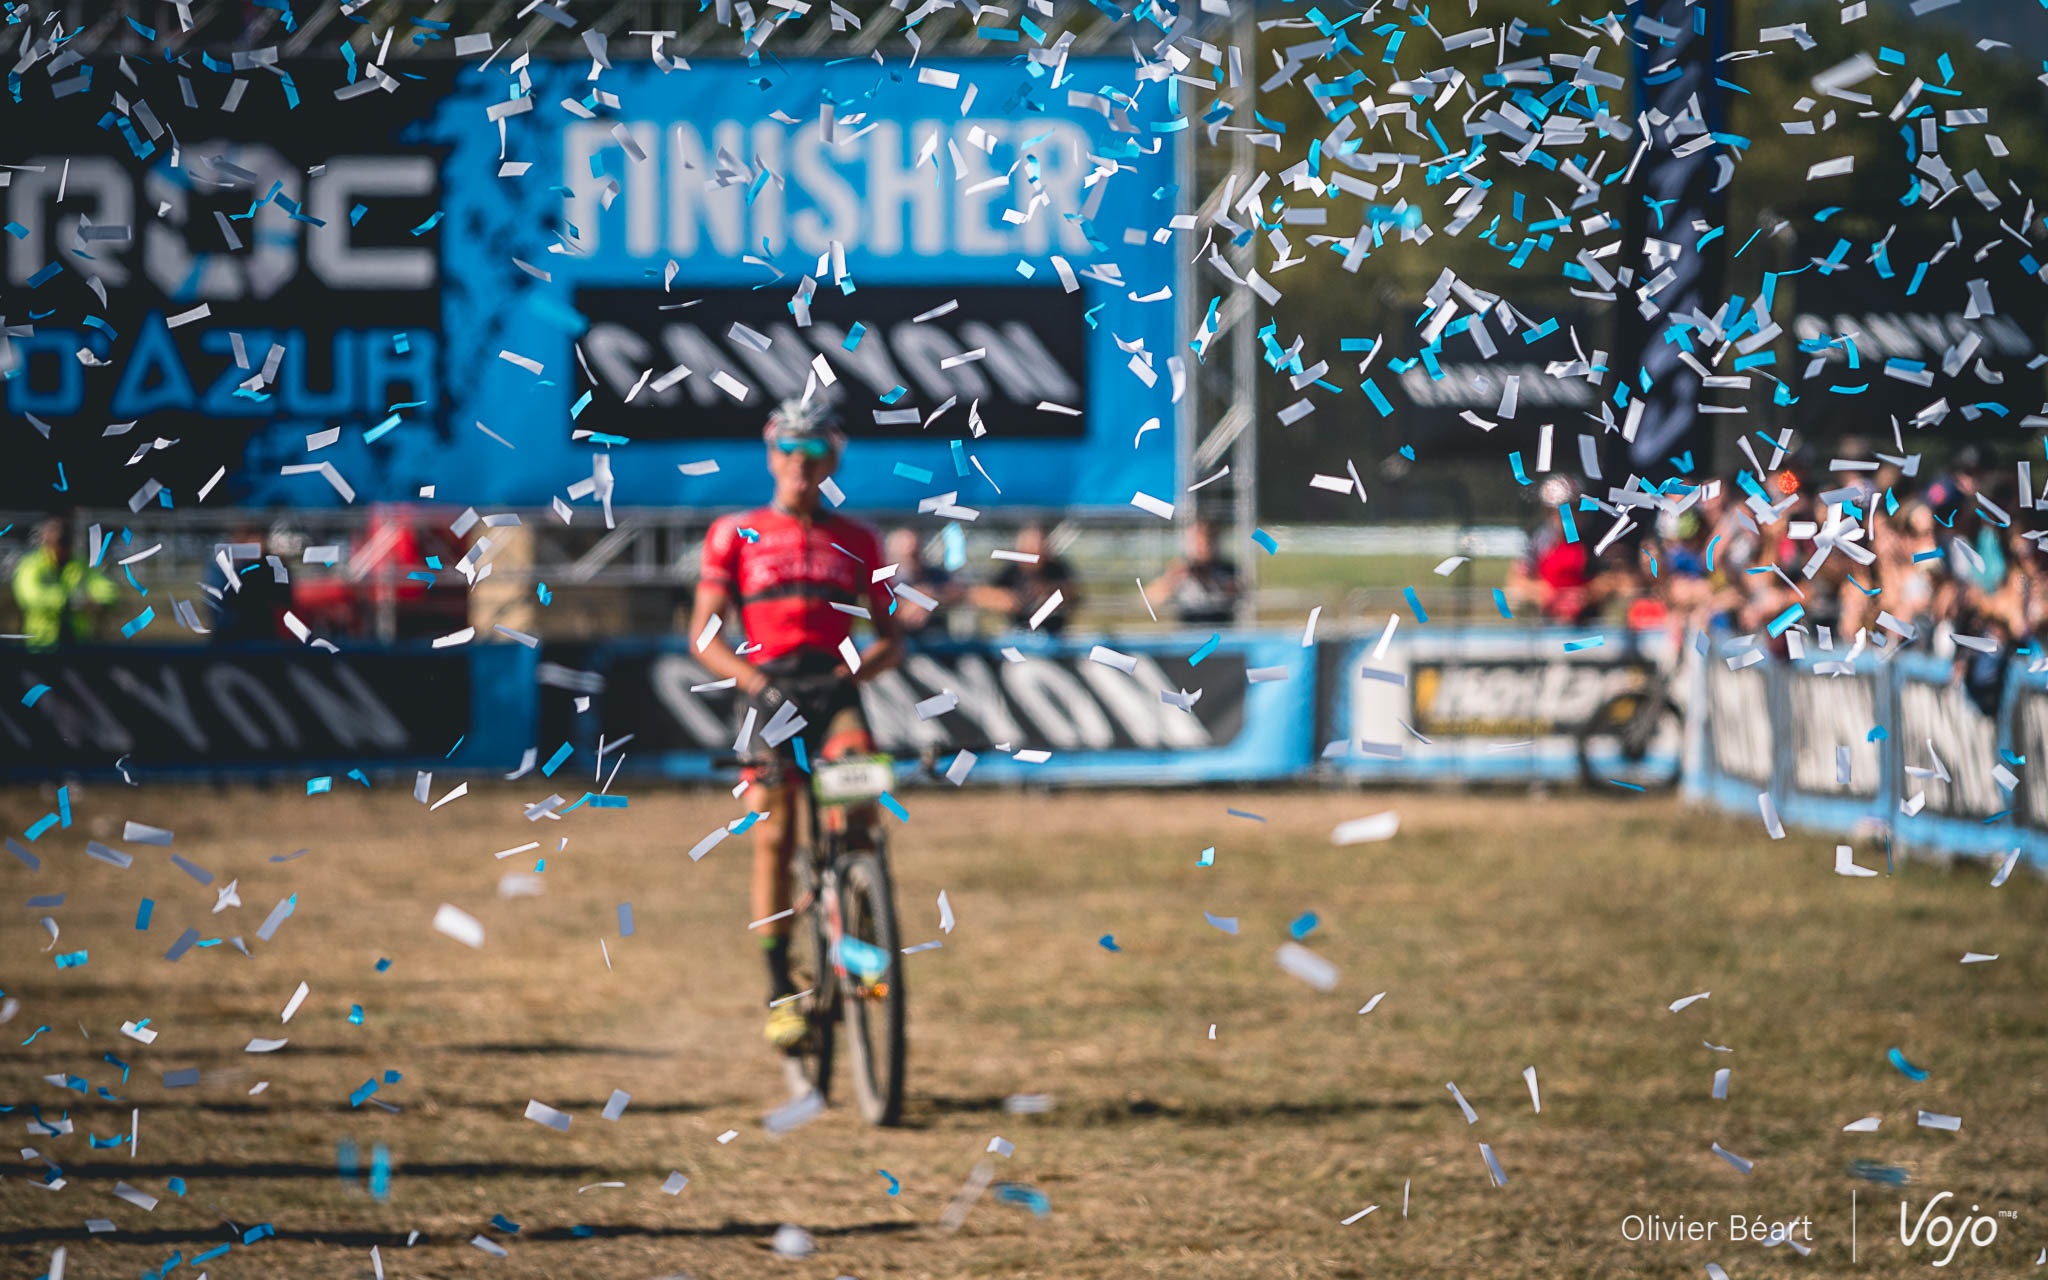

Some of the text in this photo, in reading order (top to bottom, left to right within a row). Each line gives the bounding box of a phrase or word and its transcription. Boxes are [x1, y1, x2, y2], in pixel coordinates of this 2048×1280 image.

[6, 141, 437, 301] ROC
[562, 117, 1094, 257] FINISHER
[4, 307, 438, 417] D'AZUR
[584, 319, 1082, 405] CANYON
[650, 653, 1214, 750] CNYON
